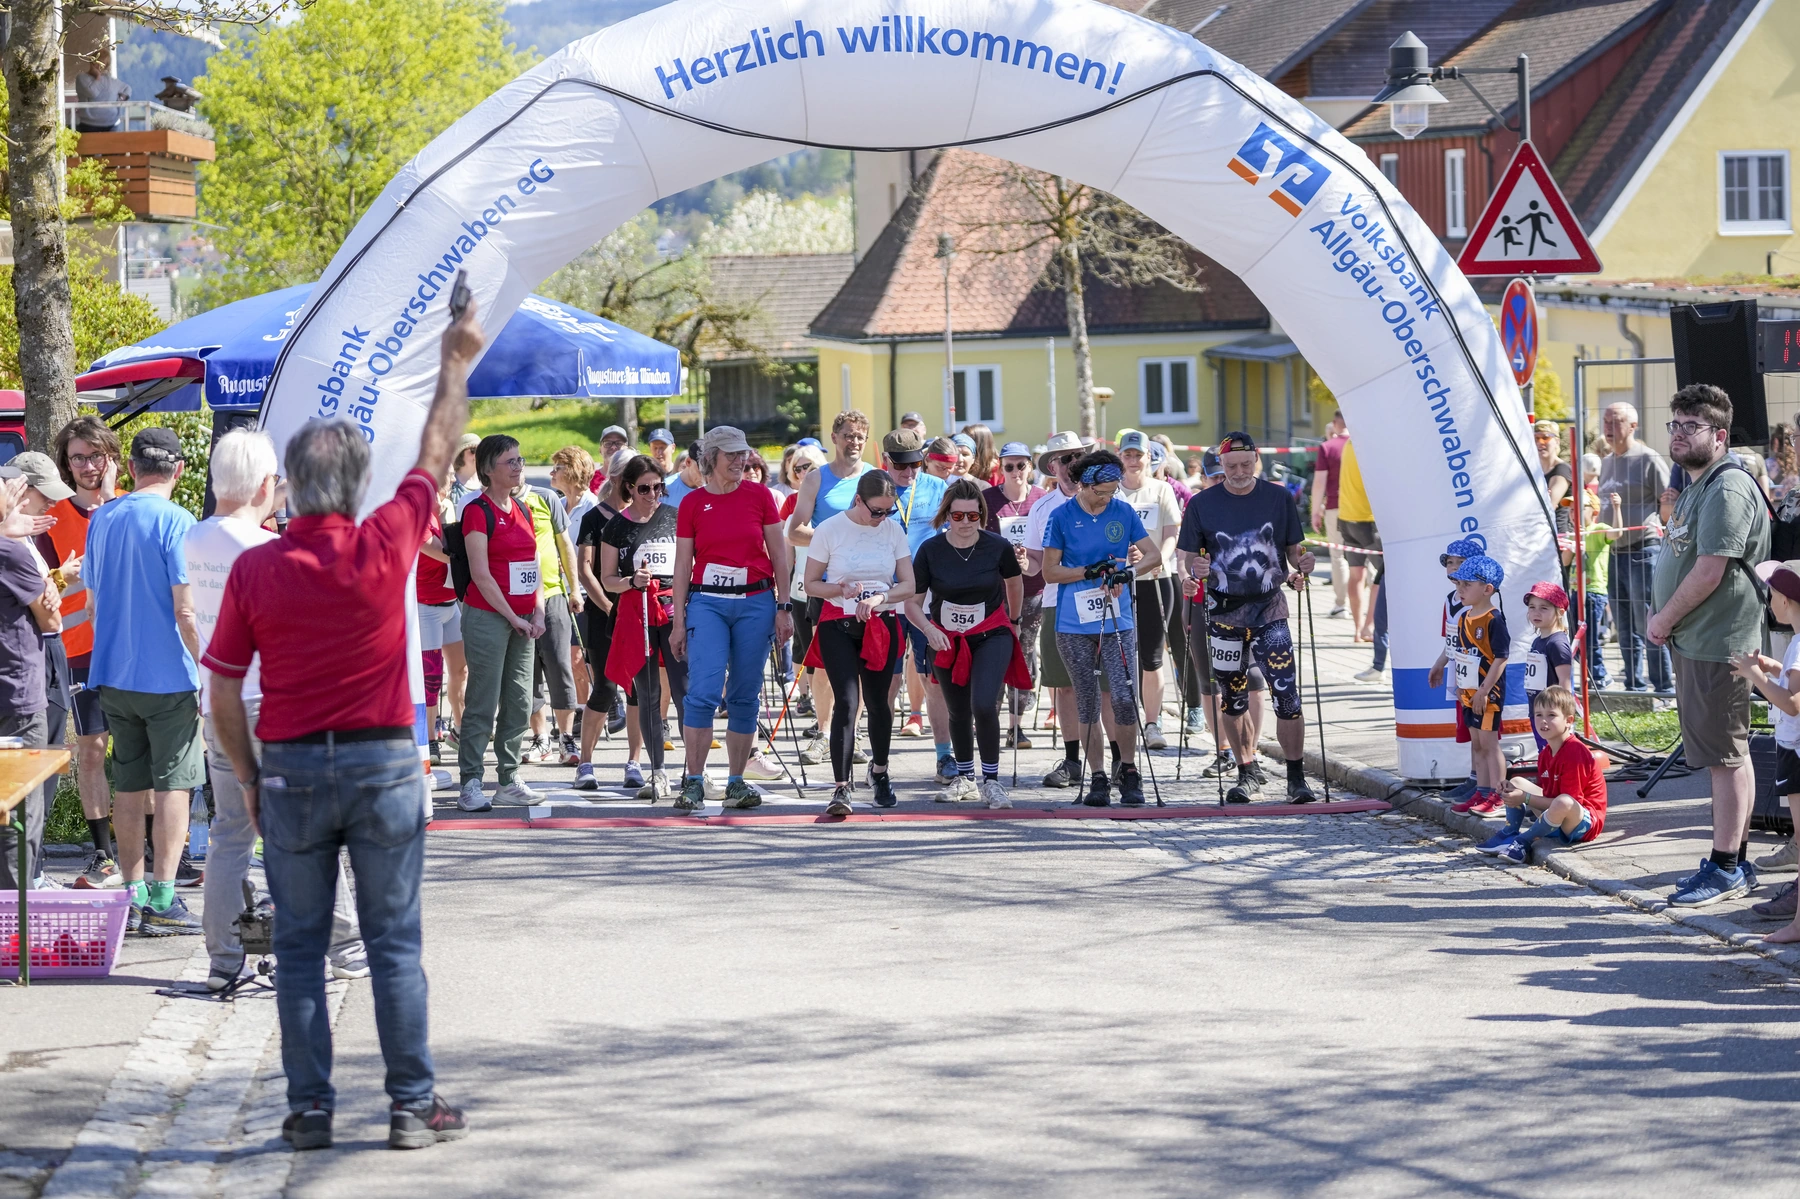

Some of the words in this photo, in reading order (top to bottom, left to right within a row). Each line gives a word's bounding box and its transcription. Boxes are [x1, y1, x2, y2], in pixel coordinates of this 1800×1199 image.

[655, 20, 825, 99] Herzlich
[837, 15, 1125, 95] willkommen!
[517, 158, 555, 195] eG
[1340, 193, 1440, 321] Volksbank
[1309, 220, 1475, 508] Allgäu-Oberschwaben
[644, 552, 667, 564] 365
[188, 561, 202, 571] Die
[197, 578, 208, 588] ist
[209, 579, 224, 589] das
[520, 571, 536, 583] 369
[712, 574, 735, 587] 371
[1087, 597, 1106, 611] 39
[951, 612, 975, 625] 354
[1211, 645, 1241, 662] 0869
